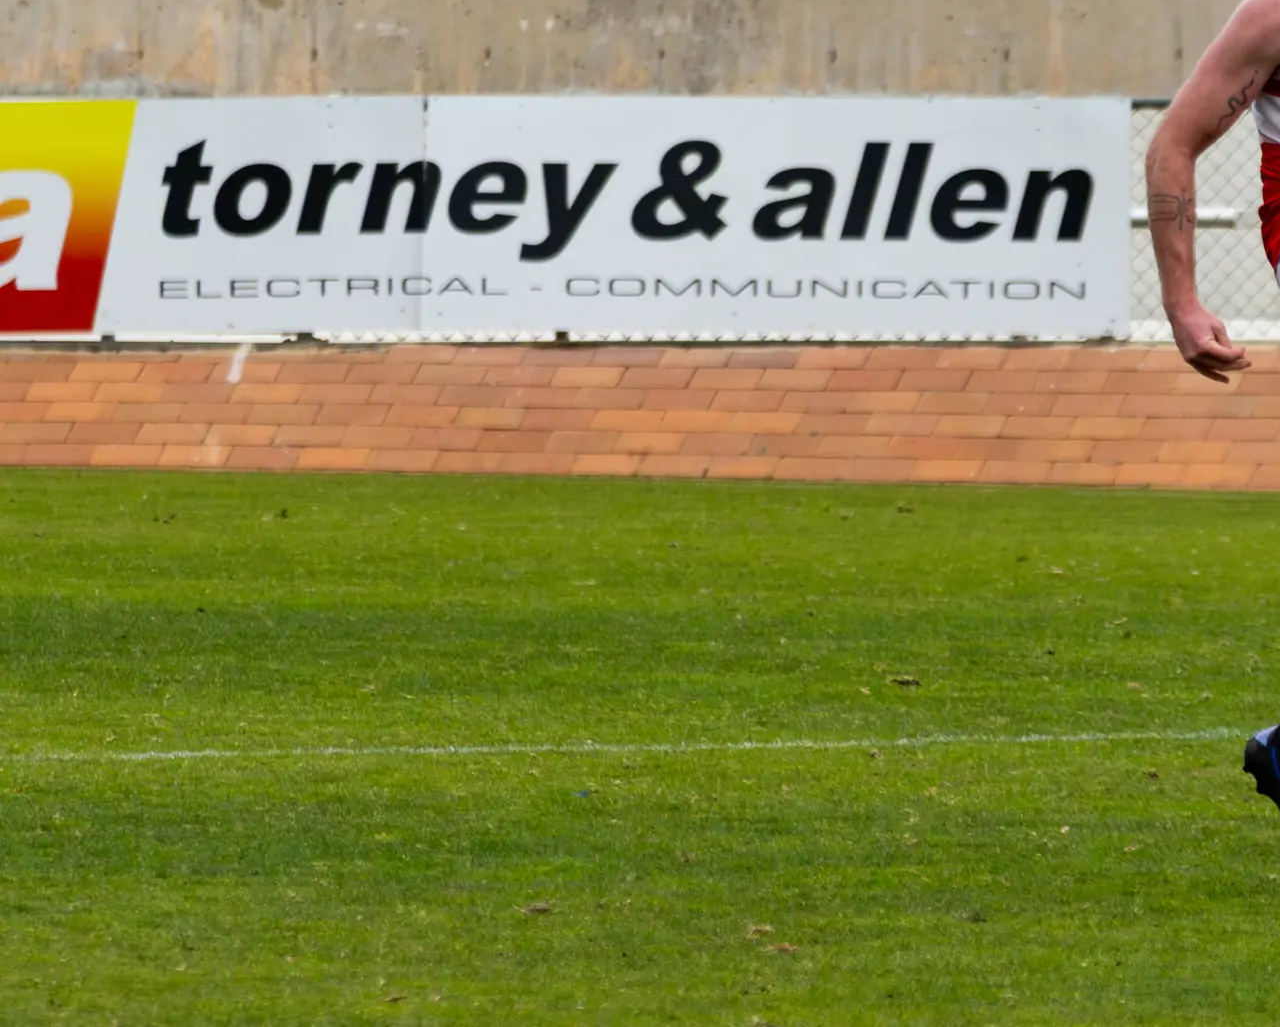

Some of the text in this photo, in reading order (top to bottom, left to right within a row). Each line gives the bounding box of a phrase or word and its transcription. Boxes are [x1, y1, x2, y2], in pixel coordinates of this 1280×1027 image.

[0, 169, 73, 291] a
[161, 139, 1095, 262] torney & allen
[158, 278, 507, 299] ELECTRICAL
[566, 277, 1086, 301] COMMUNICATION
